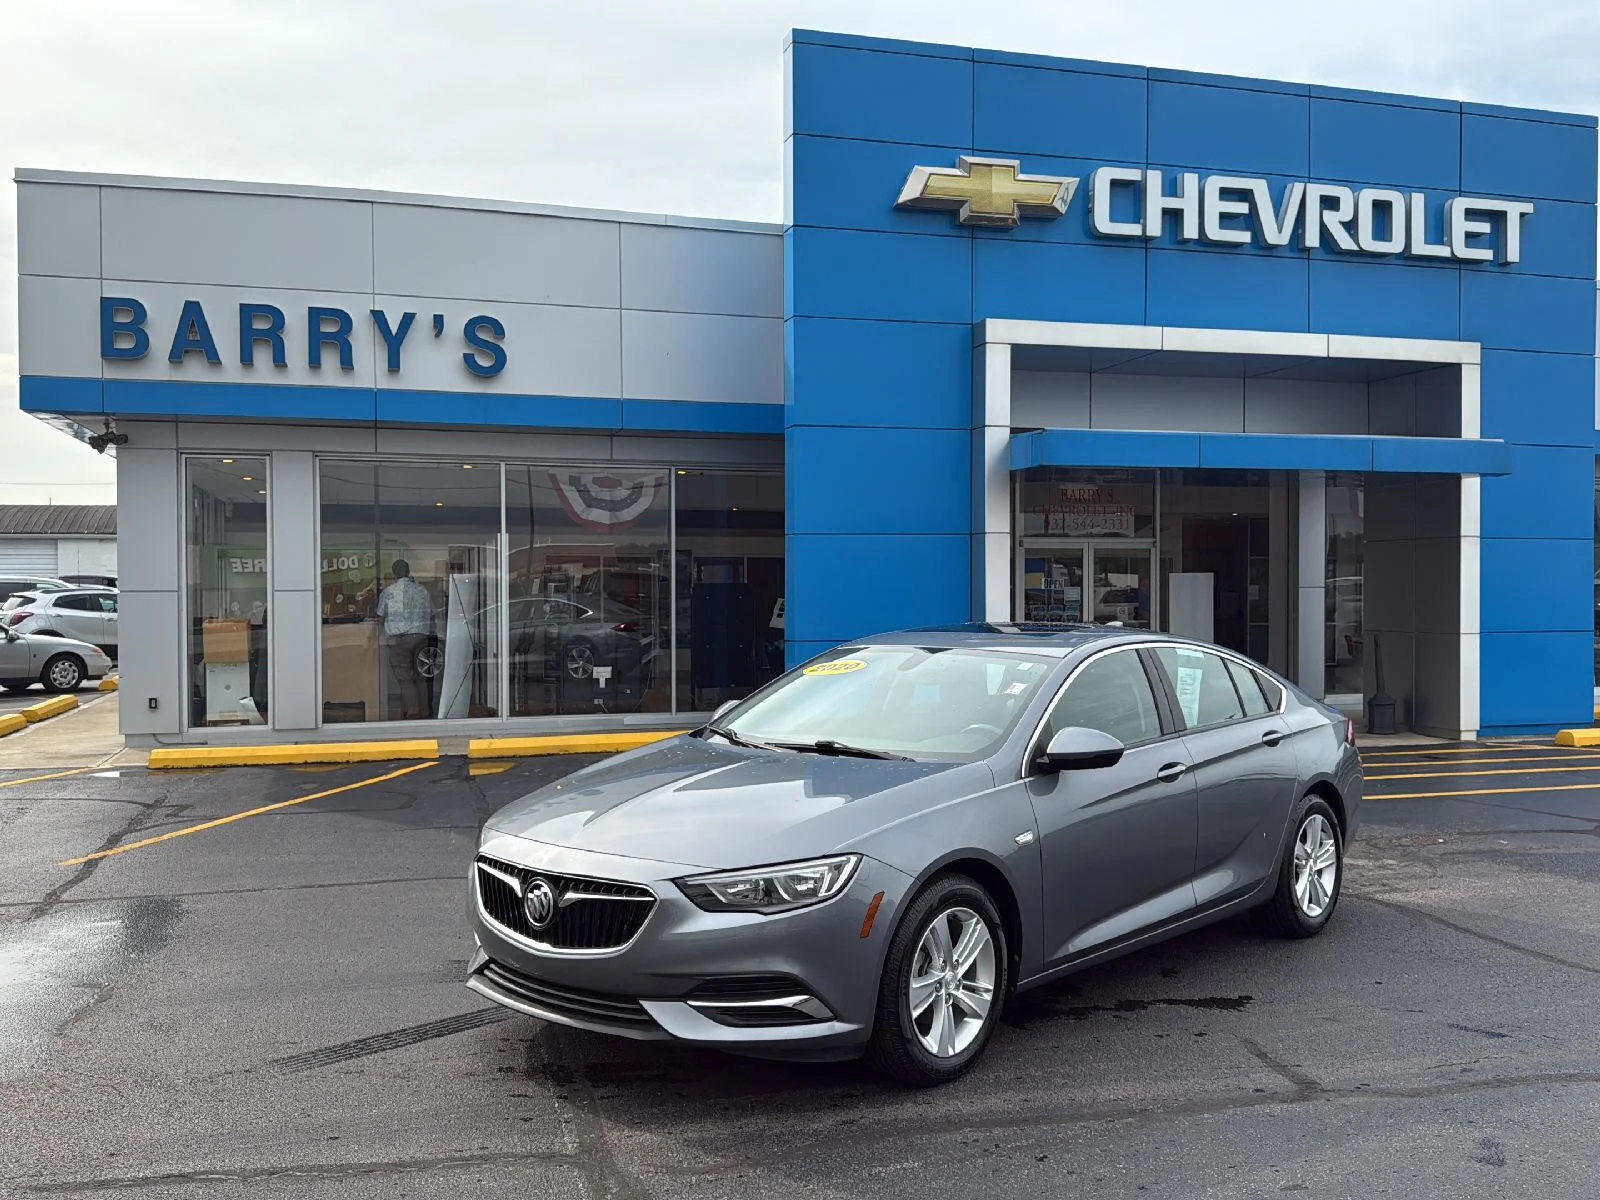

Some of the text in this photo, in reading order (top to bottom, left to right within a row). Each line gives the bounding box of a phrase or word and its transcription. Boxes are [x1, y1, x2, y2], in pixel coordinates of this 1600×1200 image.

[1090, 166, 1535, 264] CHEVROLET
[99, 296, 508, 379] BARRY'S
[1043, 578, 1063, 589] OPEN
